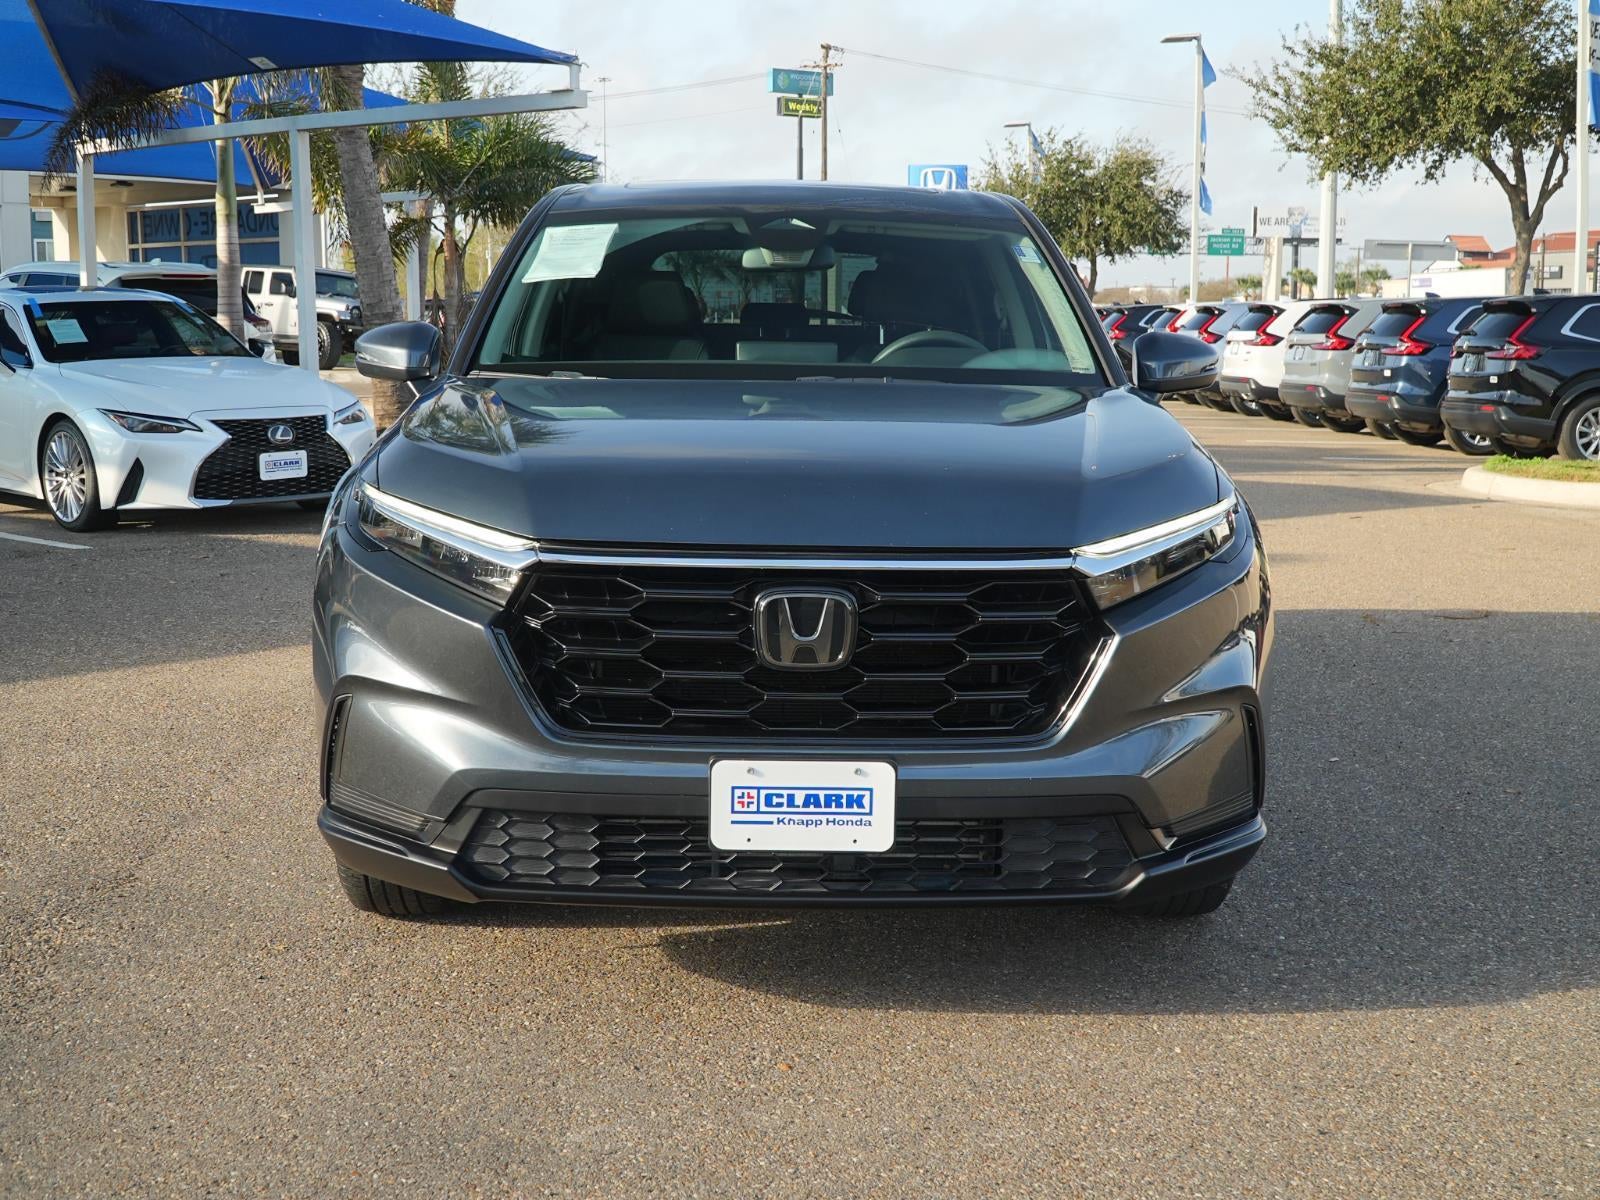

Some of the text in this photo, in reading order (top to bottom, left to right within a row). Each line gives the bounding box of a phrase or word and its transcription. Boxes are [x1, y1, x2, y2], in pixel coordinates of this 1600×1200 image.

[788, 102, 817, 113] Weekly
[1259, 217, 1290, 226] WE ARE
[764, 793, 866, 809] CLARK
[777, 817, 872, 828] Knapp Honda
